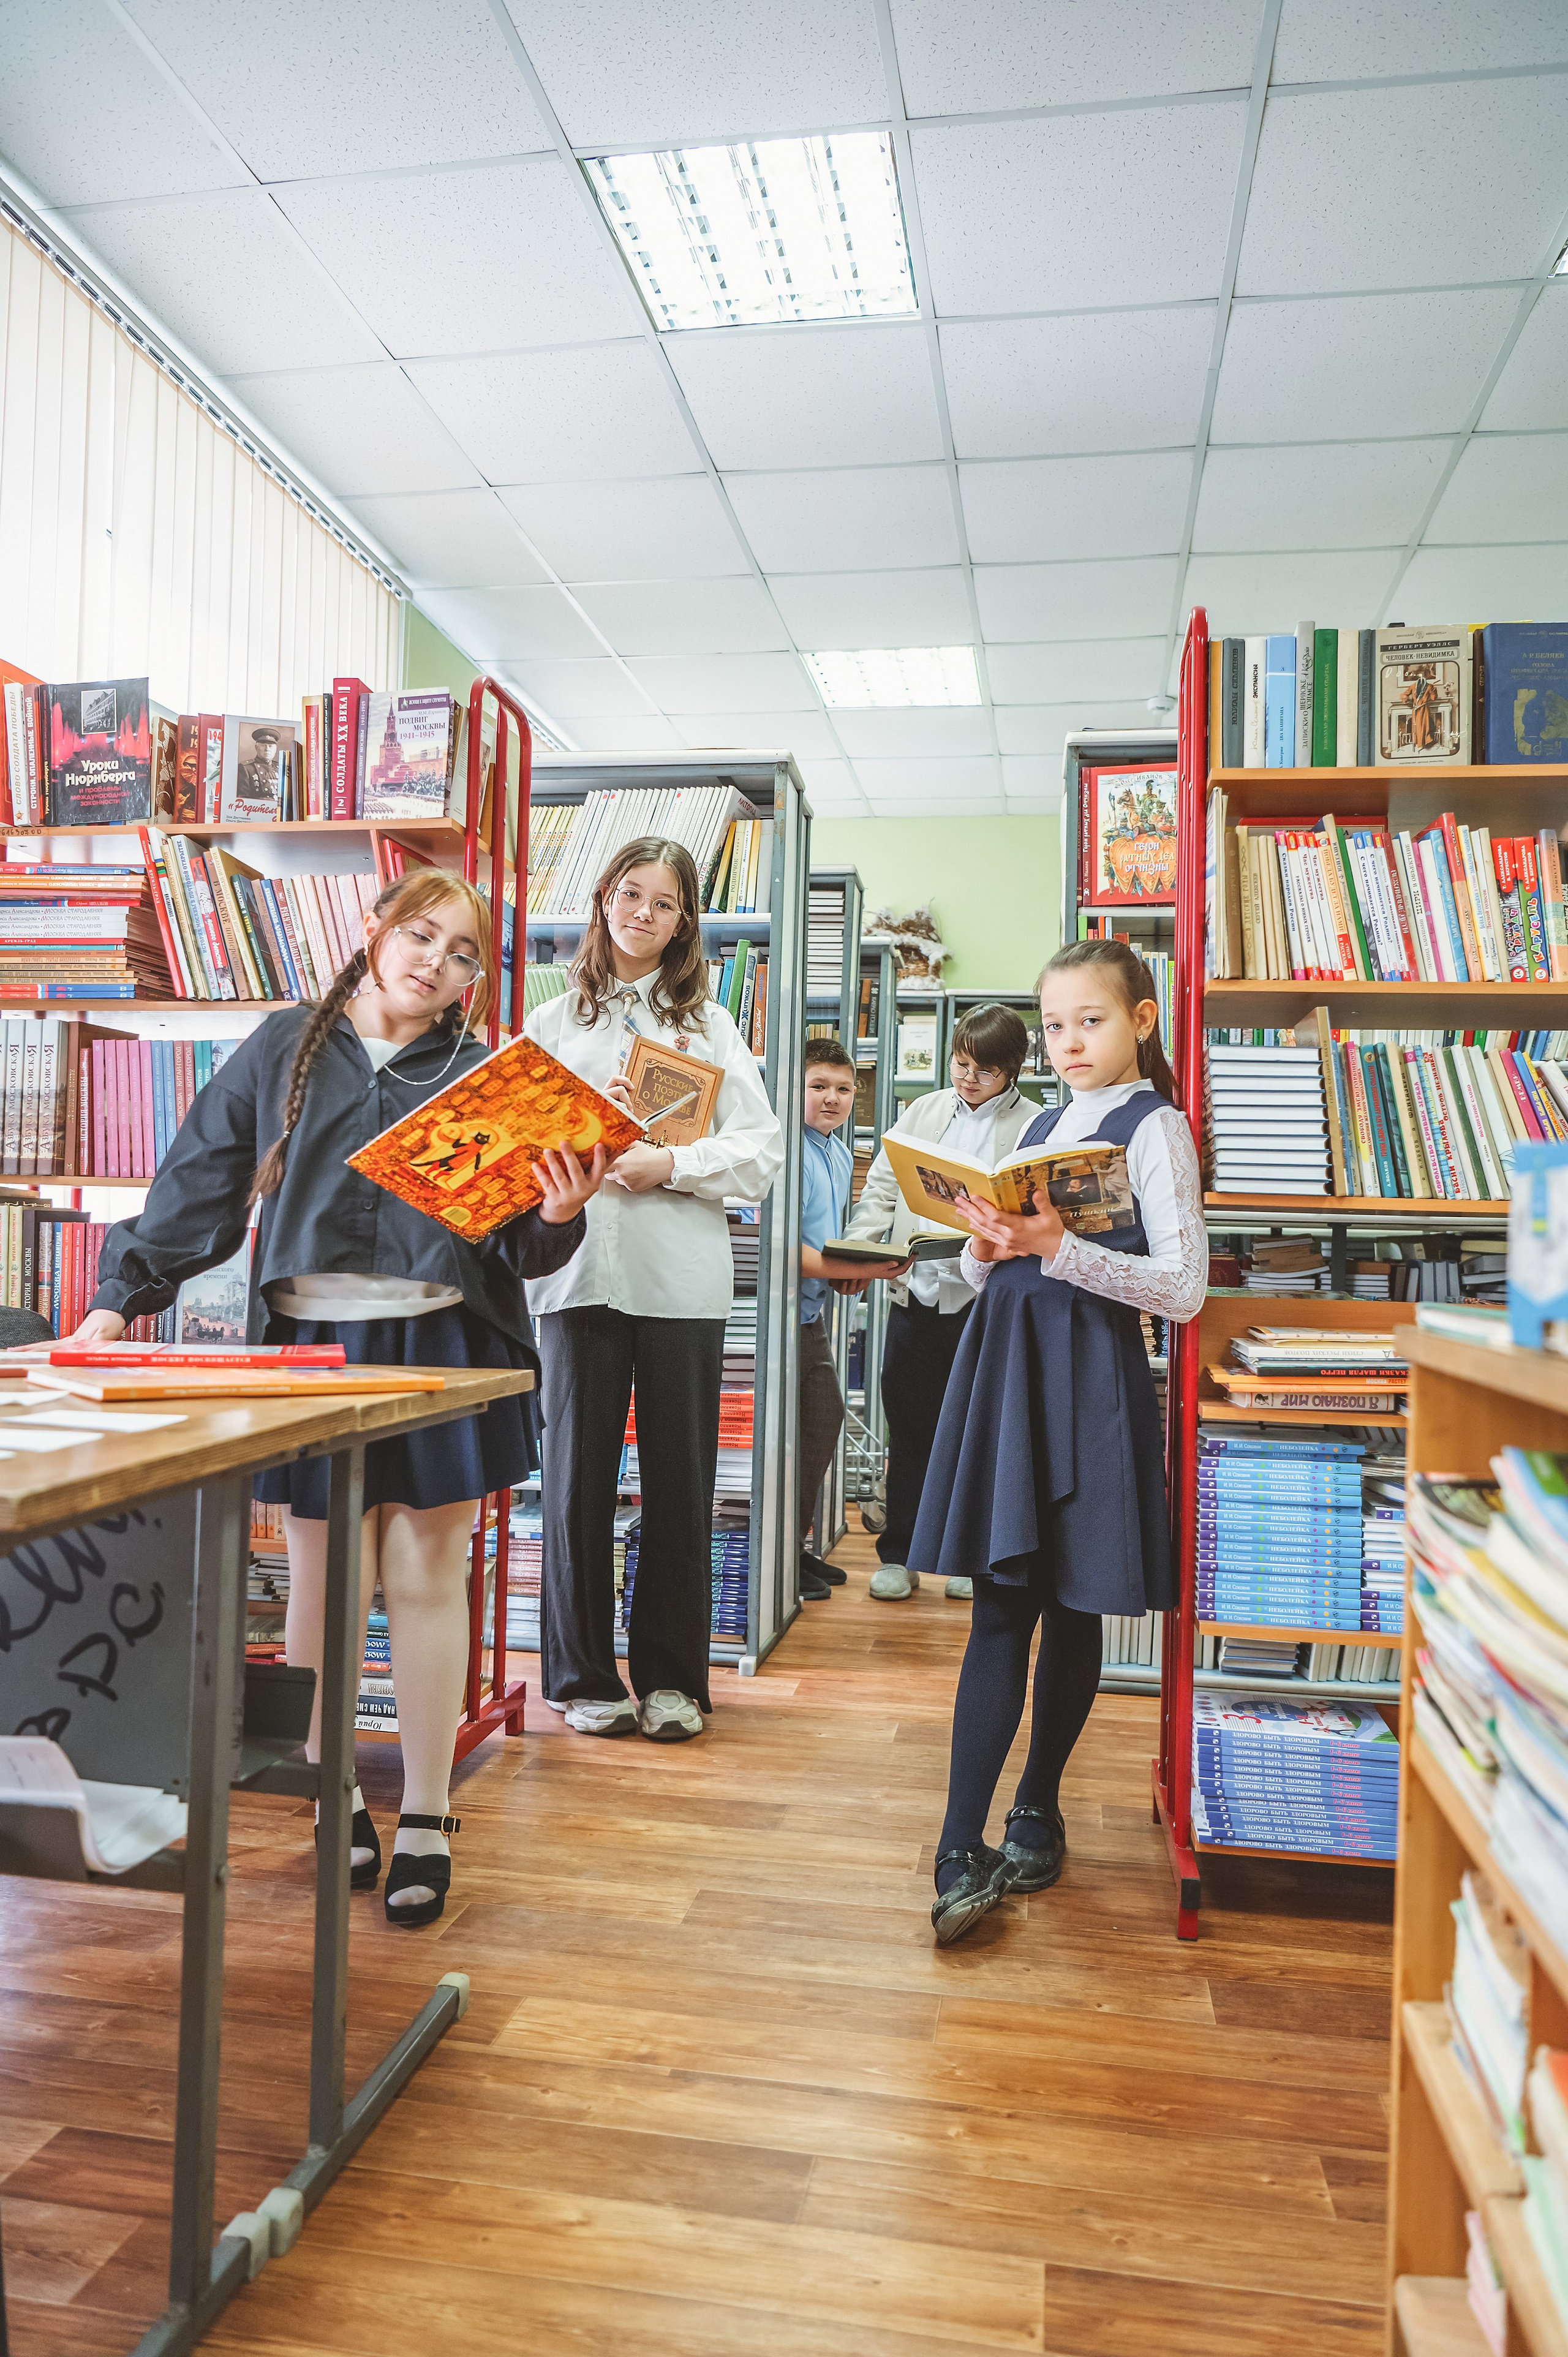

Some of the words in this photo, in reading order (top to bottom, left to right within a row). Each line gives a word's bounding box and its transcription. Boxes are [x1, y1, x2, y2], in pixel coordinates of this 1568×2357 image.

[1385, 651, 1455, 662] ЧЕЛОВЕК-НЕВИДИМКА
[25, 696, 34, 728] ВОЙНОЙ
[339, 697, 348, 722] ВЕКА
[399, 716, 429, 725] ПОДВИГ
[413, 722, 446, 731] МОСКВЫ
[65, 771, 136, 788] Нюрнберга
[81, 760, 119, 774] Уроки
[336, 745, 346, 793] СОЛДАТЫ
[70, 791, 130, 801] международной
[85, 786, 121, 795] проблемы
[176, 840, 188, 870] ОТКРЫТКЕ
[1125, 863, 1169, 875] ОТЧИЗНЫ
[149, 869, 160, 904] КРЕМЛЬ-ГРАД
[184, 870, 194, 898] ПОЧТОВОЙ
[233, 881, 246, 909] ЭКСКУРСИЯХ
[1305, 867, 1314, 900] мужества
[1315, 869, 1324, 900] мужества
[192, 904, 202, 927] МОСКВЫ
[1365, 879, 1376, 918] начинается
[1373, 919, 1382, 945] Родина?
[1374, 877, 1385, 916] начинается
[1384, 916, 1392, 943] Родина?
[198, 929, 207, 954] ИСТОРИЯ
[205, 919, 216, 940] нашего
[213, 942, 224, 968] детства
[214, 889, 230, 925] МОСКВЕ
[225, 927, 243, 974] интересно!
[275, 924, 290, 962] МОСКВА
[1502, 908, 1516, 957] ЗАСТЕНЧИВЫЙ
[1510, 908, 1521, 953] ТРУБАЧ
[1527, 897, 1545, 963] КАРУСЕЛЬ
[9, 1044, 20, 1109] МОСКОВСКАЯ
[26, 1044, 37, 1109] МОСКОВСКАЯ
[43, 1044, 54, 1109] МОСКОВСКАЯ
[1349, 1049, 1360, 1089] ГОРЫНЫЧУ!
[1428, 1053, 1442, 1091] НЕЗНАЙКИ
[1414, 1081, 1424, 1107] ЗЕРКАЛ
[1438, 1093, 1449, 1121] ОСТРОВ
[6, 1114, 15, 1150] АЗБУКА
[23, 1114, 33, 1150] АЗБУКА
[40, 1114, 50, 1150] АЗБУКА
[1420, 1111, 1431, 1141] КРИВЫХ
[1470, 1103, 1484, 1137] ВОЛШЕБНОЕ
[1438, 1119, 1453, 1160] КРЫЛОВА
[1426, 1144, 1442, 1194] КОРОЛЕВСТВО
[1280, 1393, 1309, 1406] МИР
[1312, 1395, 1365, 1408] ПОЗНАЮ
[1368, 1396, 1379, 1409] Я
[368, 1683, 394, 1695] ОСКВА
[369, 1703, 382, 1714] ЧЕМ
[383, 1703, 396, 1714] НАД
[358, 1721, 383, 1730] Юрий
